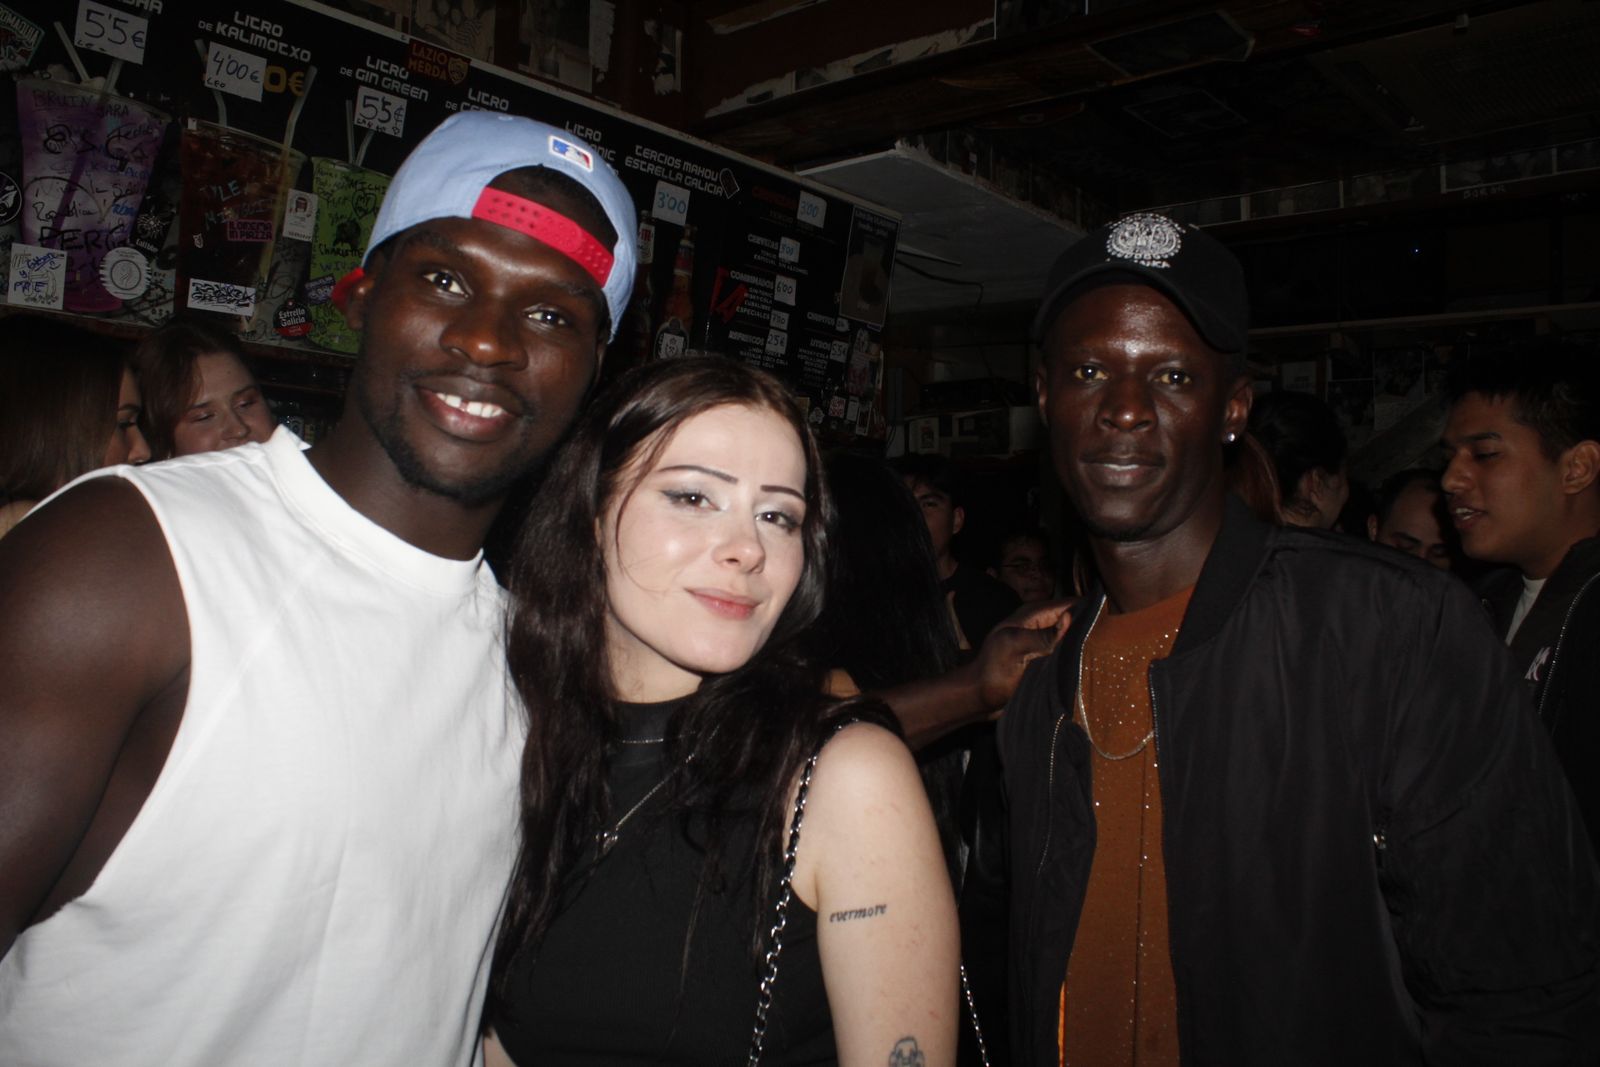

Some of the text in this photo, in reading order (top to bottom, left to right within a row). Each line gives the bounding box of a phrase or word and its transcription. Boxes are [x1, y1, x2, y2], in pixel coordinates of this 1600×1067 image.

[198, 20, 213, 32] DE
[234, 11, 283, 38] LITRO
[411, 43, 447, 65] LAZIO
[366, 55, 409, 80] LITRO
[407, 58, 447, 81] MERDA
[339, 67, 429, 102] DE GIN GREEN
[445, 100, 458, 112] DE
[468, 88, 510, 112] LITRO
[565, 120, 602, 143] LITRO
[635, 144, 720, 181] TERCIOS MAHOU
[624, 156, 683, 184] ESTRELLA
[684, 175, 724, 197] GALICIA
[278, 308, 306, 320] Estrella
[280, 317, 306, 327] Galicia
[829, 904, 887, 923] evermore
